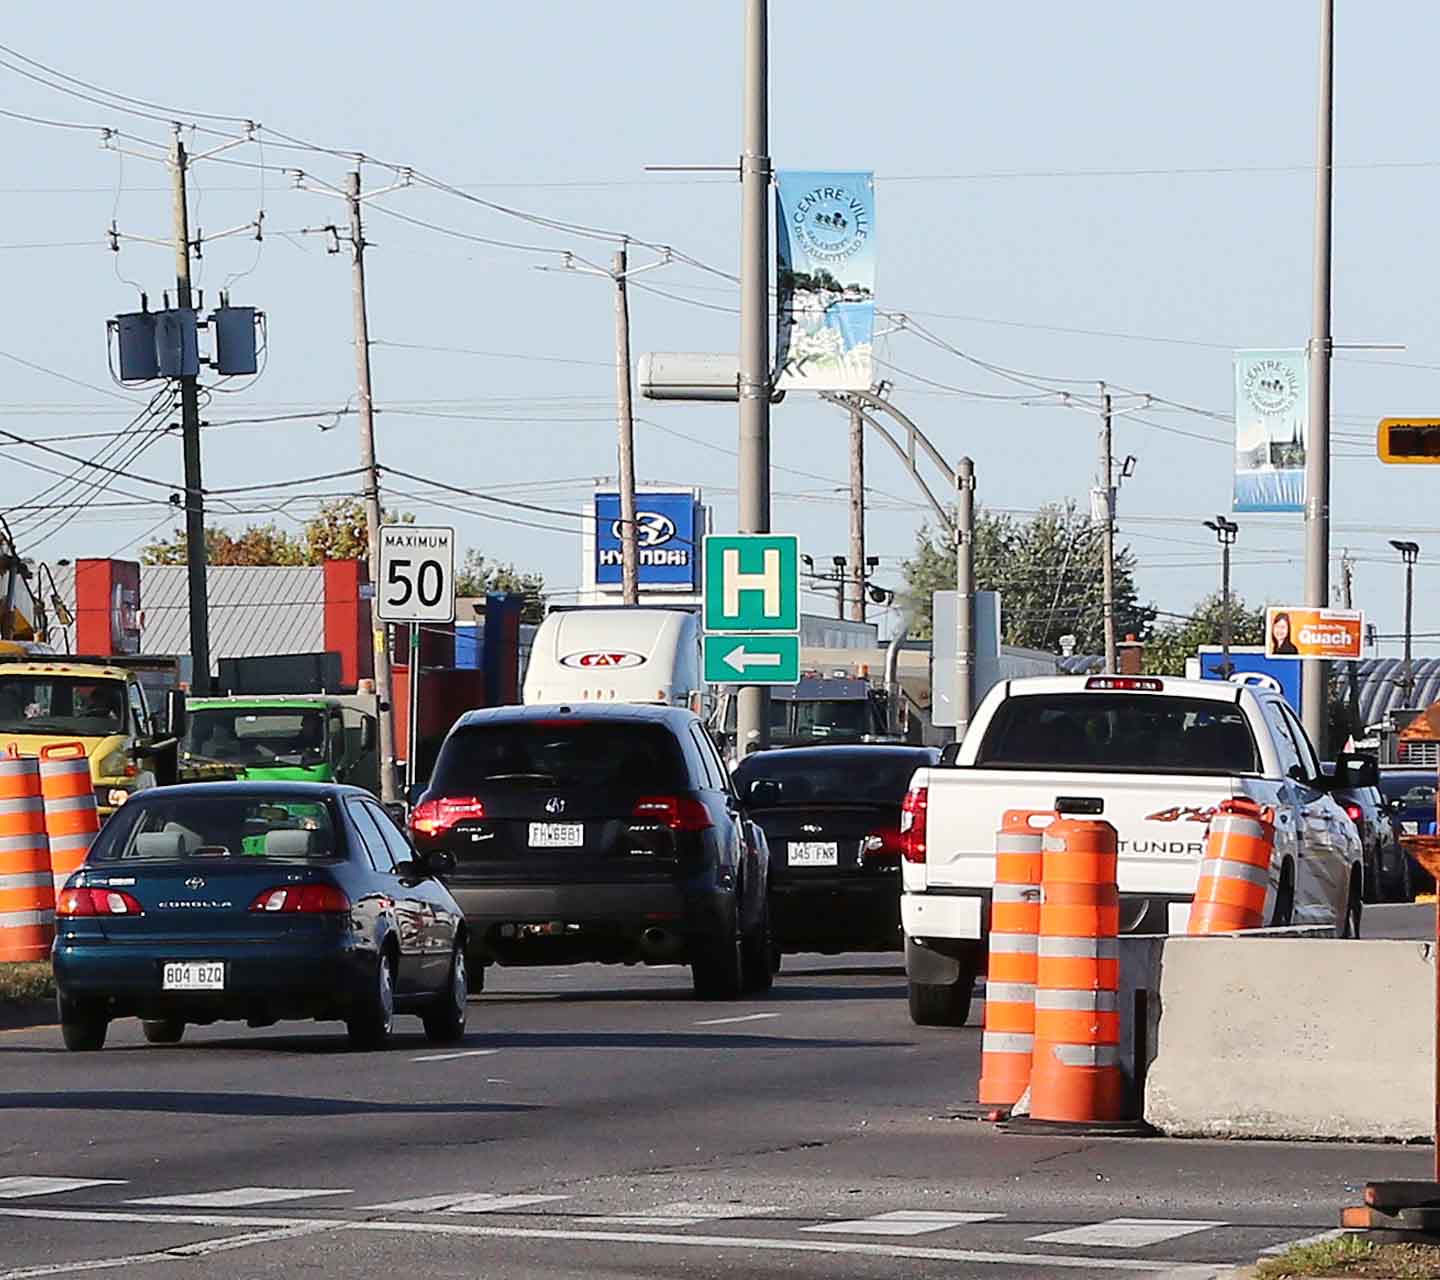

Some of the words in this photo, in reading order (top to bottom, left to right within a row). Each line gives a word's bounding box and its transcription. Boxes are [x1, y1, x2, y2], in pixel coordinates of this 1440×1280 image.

[794, 187, 867, 240] CENTRE-VILLE
[385, 535, 448, 548] MAXIMUM
[599, 549, 687, 565] HYNDAI
[387, 559, 444, 607] 50
[723, 548, 781, 617] H
[1298, 629, 1352, 645] Quach
[1118, 840, 1203, 854] TUNDR
[166, 967, 190, 984] 804
